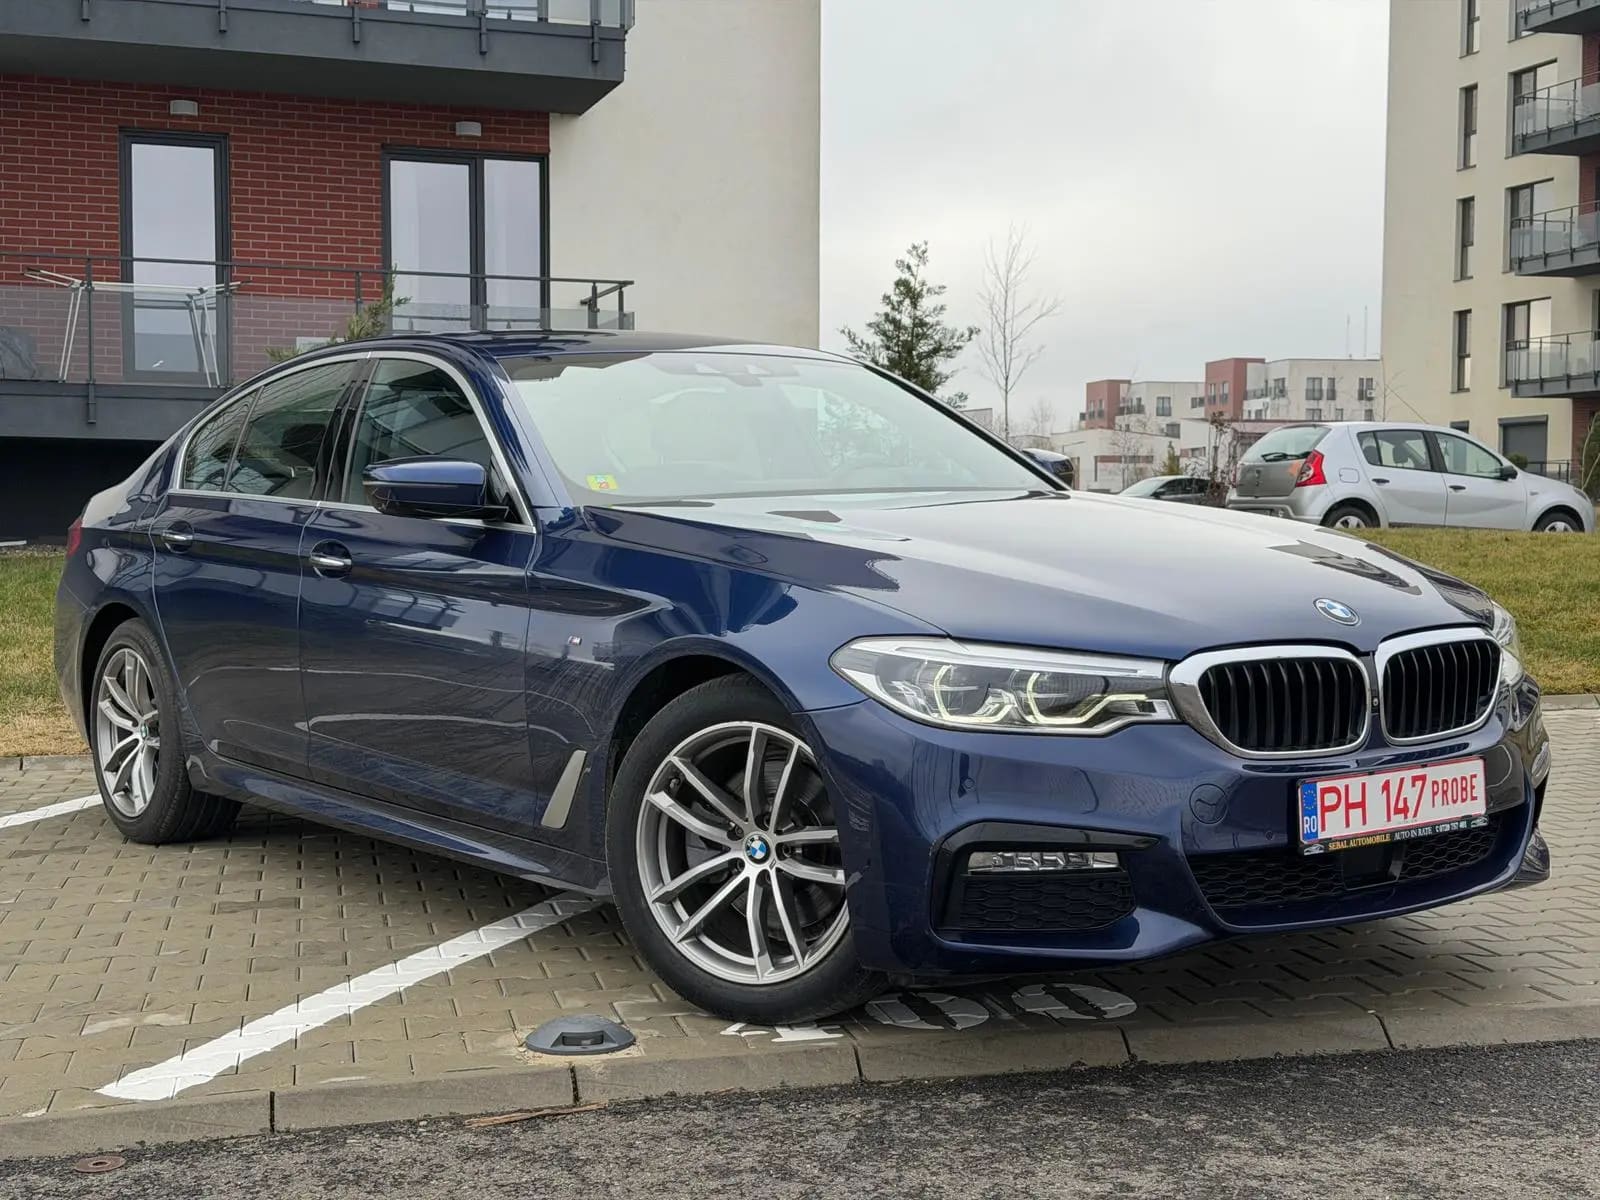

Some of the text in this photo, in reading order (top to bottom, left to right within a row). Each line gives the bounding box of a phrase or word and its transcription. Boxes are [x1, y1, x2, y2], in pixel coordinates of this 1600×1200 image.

[1319, 773, 1478, 832] PH 147 PROBE
[1304, 816, 1317, 834] RO
[1350, 834, 1391, 848] AUTOMOBILE
